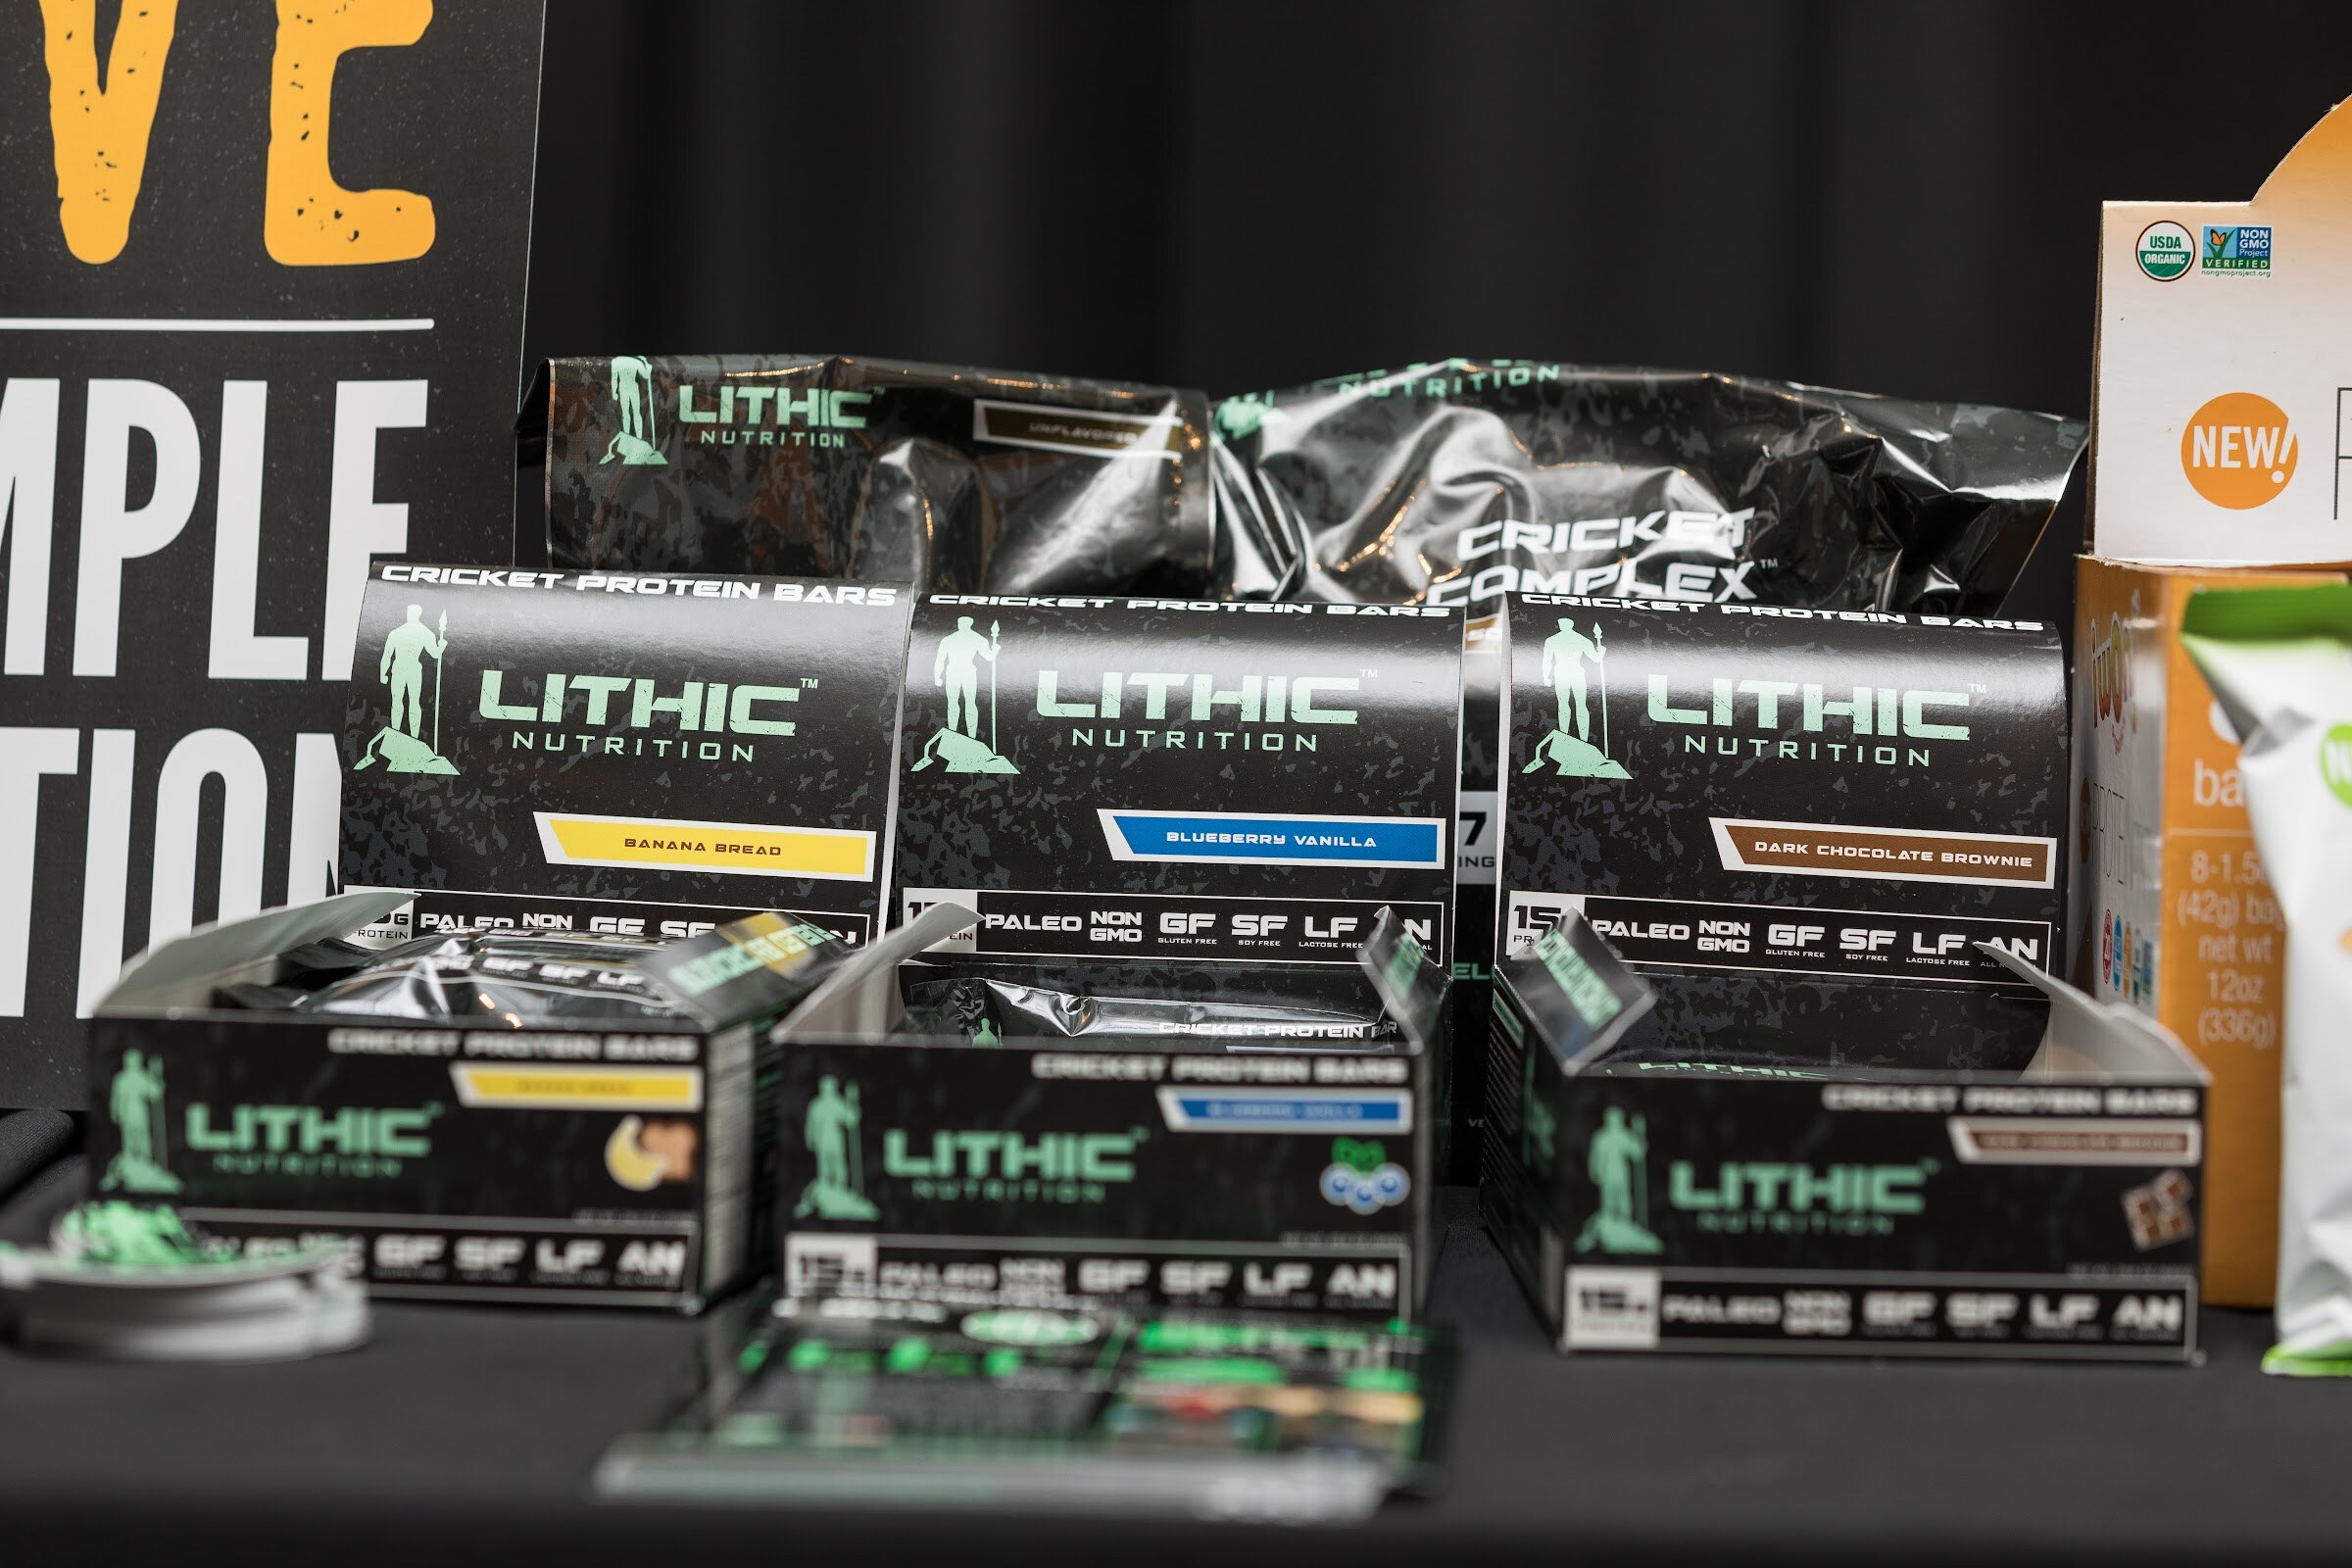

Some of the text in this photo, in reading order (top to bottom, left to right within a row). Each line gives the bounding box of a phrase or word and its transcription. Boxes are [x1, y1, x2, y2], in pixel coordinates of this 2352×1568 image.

[2149, 235, 2181, 249] USDA
[2239, 239, 2269, 249] GMO
[2240, 229, 2269, 239] NON
[2144, 253, 2185, 265] ORGANIC
[2205, 259, 2268, 269] VERIFIED
[2238, 249, 2269, 258] Project
[679, 385, 872, 428] LITHIC
[701, 430, 845, 448] NUTRITION
[2192, 424, 2298, 484] NEW!
[1457, 508, 1755, 562] CRICKET
[381, 565, 897, 607] CRICKET PROTEIN BARS
[1425, 561, 1758, 608] COMPLEX
[930, 594, 1450, 617] CRICKET PROTEIN BARS
[1522, 594, 2043, 631] CRICKET PROTEIN BARS
[478, 669, 801, 737] LITHIC
[1037, 669, 1359, 724] LITHIC
[1647, 673, 1970, 742] LITHIC
[512, 732, 755, 763] NUTRITION
[1072, 728, 1317, 753] NUTRITION
[1686, 734, 1930, 767] NUTRITION
[1166, 831, 1377, 848] BLUEBERRY VANILLA
[2092, 782, 2132, 888] PROTE
[624, 838, 781, 857] BANANA BREAD
[1755, 841, 2033, 867] DARK CHOCOLATE BROWNIE
[522, 913, 572, 930] NON
[1091, 911, 1142, 925] NON
[2177, 889, 2240, 930] (42g)
[357, 929, 408, 939] ROTEIN
[985, 914, 1082, 931] PALEO
[1159, 912, 1216, 934] GF
[1231, 914, 1288, 936] SF
[1304, 916, 1358, 938] LF
[1592, 919, 1690, 940] PALEO
[1698, 920, 1750, 936] NON
[1090, 928, 1142, 942] GMO
[1697, 937, 1749, 953] GMO
[1768, 923, 1825, 947] GF
[1839, 928, 1896, 951] SF
[1913, 932, 1966, 956] LF
[1766, 949, 1799, 957] GLUTEN
[2198, 933, 2273, 963] net wt
[2208, 968, 2265, 1004] 12oz
[1159, 1023, 1259, 1036] CRICKET
[1265, 1024, 1364, 1039] PROTEIN
[2198, 1007, 2276, 1050] (336g)
[185, 1103, 432, 1156] LITHIC
[884, 1131, 1137, 1183] LITHIC
[1670, 1160, 1927, 1216] LITHIC
[454, 1237, 525, 1270] SF
[535, 1239, 605, 1272] LF
[617, 1241, 684, 1277] AN
[1244, 1263, 1312, 1297] LF
[1328, 1264, 1396, 1299] AN
[1945, 1293, 2019, 1327] SF
[2029, 1295, 2099, 1329] LF
[2112, 1296, 2181, 1332] AN
